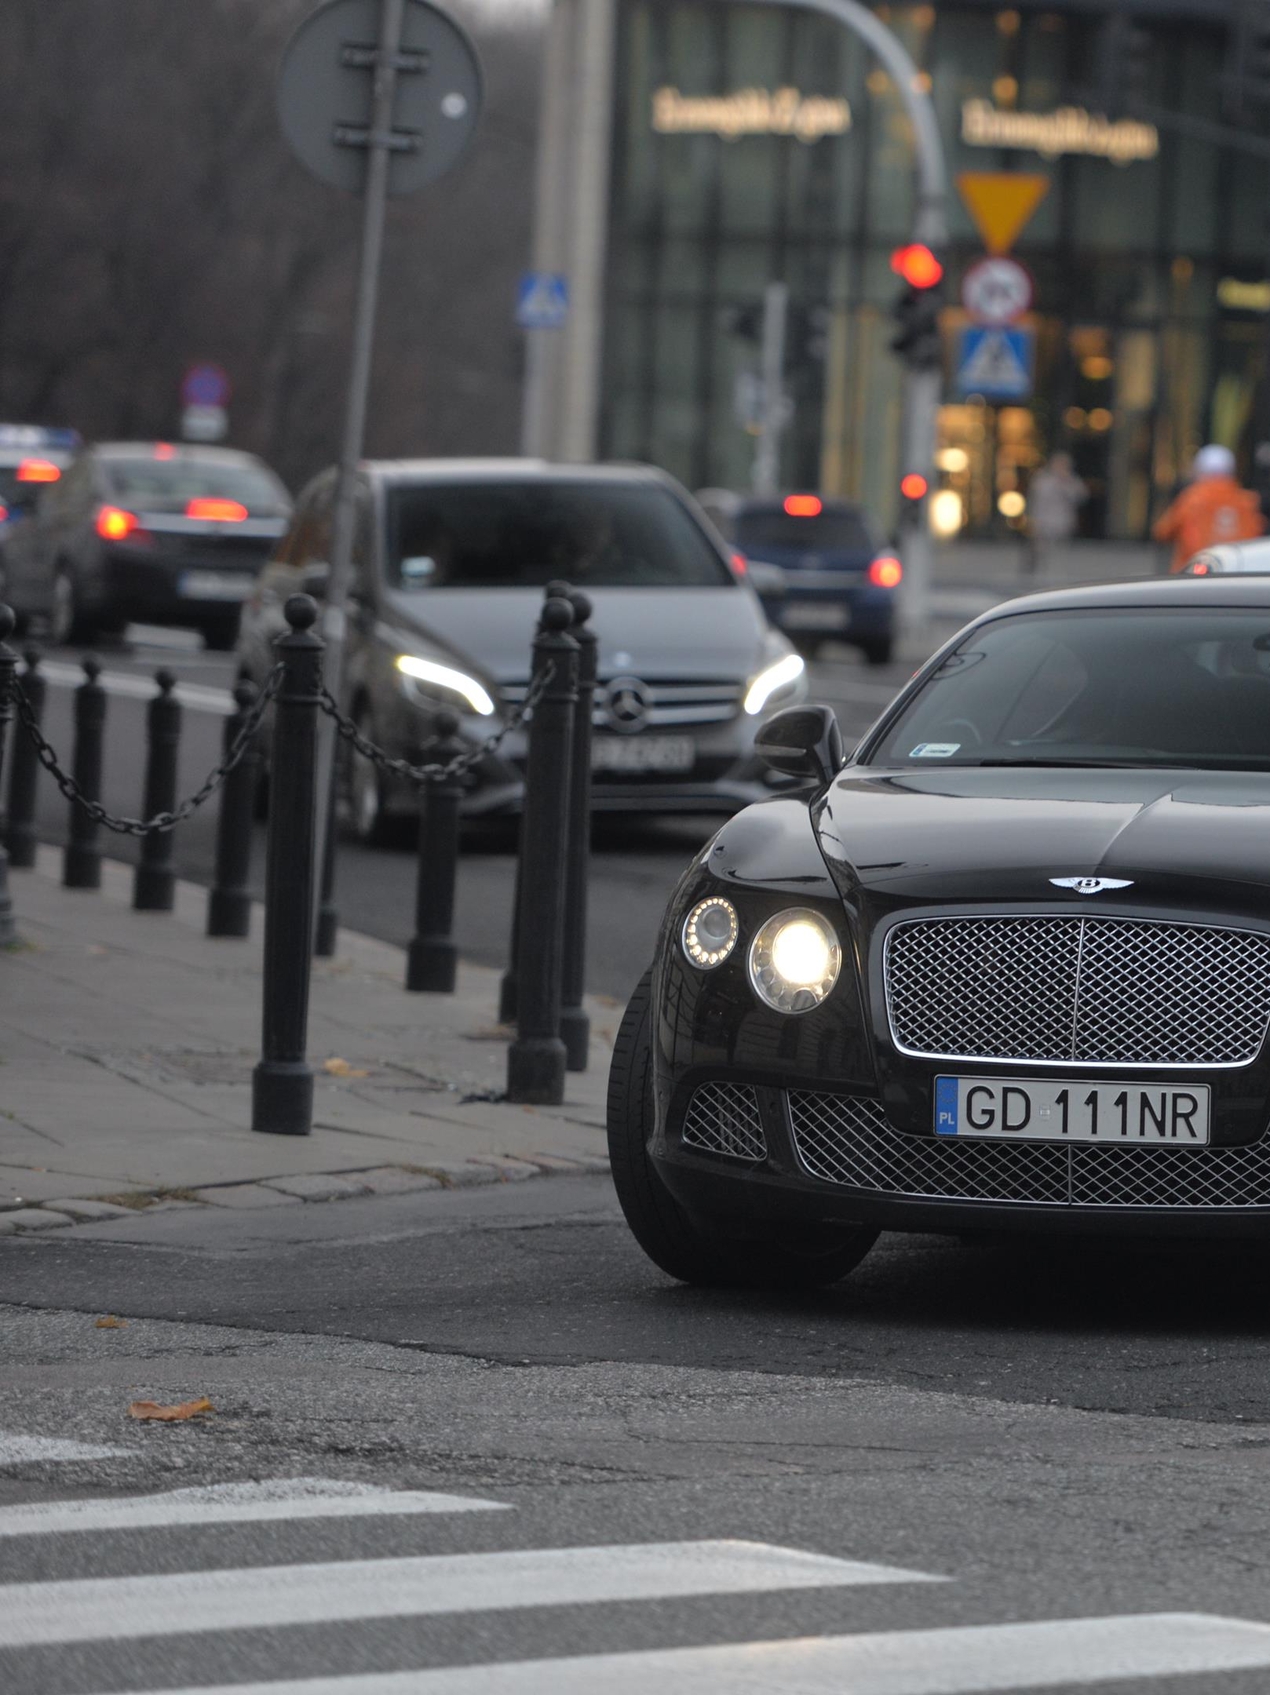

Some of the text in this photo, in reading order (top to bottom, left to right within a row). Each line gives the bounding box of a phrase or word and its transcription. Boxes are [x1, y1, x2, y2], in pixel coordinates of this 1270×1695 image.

[939, 1112, 955, 1125] PL
[966, 1085, 1199, 1138] GD 111NR
